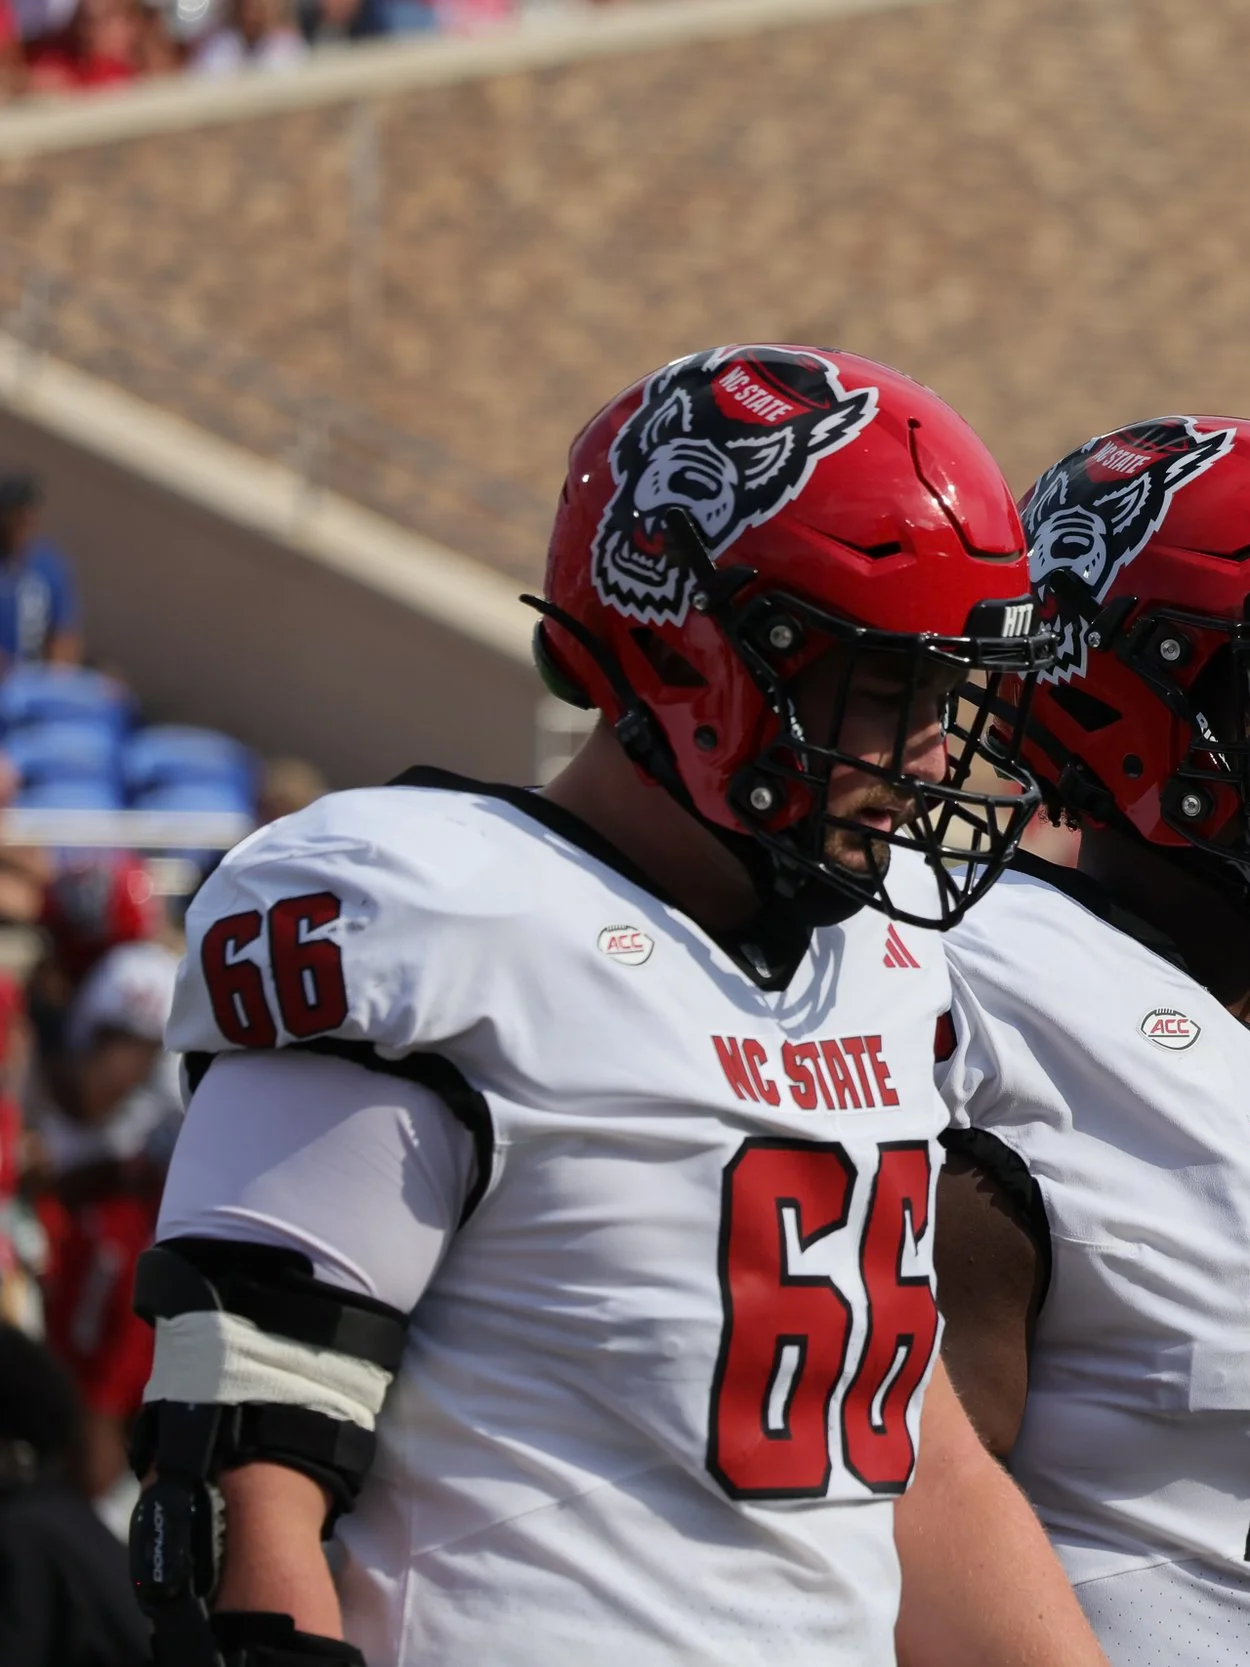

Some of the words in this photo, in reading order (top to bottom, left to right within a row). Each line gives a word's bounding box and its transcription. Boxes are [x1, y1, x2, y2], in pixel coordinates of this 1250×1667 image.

[719, 366, 750, 392] NC
[734, 384, 794, 422] STATE
[1095, 440, 1119, 463] NC
[1102, 449, 1152, 474] STATE
[607, 932, 644, 951] ACC
[201, 892, 348, 1050] 66
[1150, 1018, 1190, 1034] ACC
[710, 1035, 781, 1107] NC
[780, 1034, 900, 1110] STATE
[706, 1136, 938, 1500] 66
